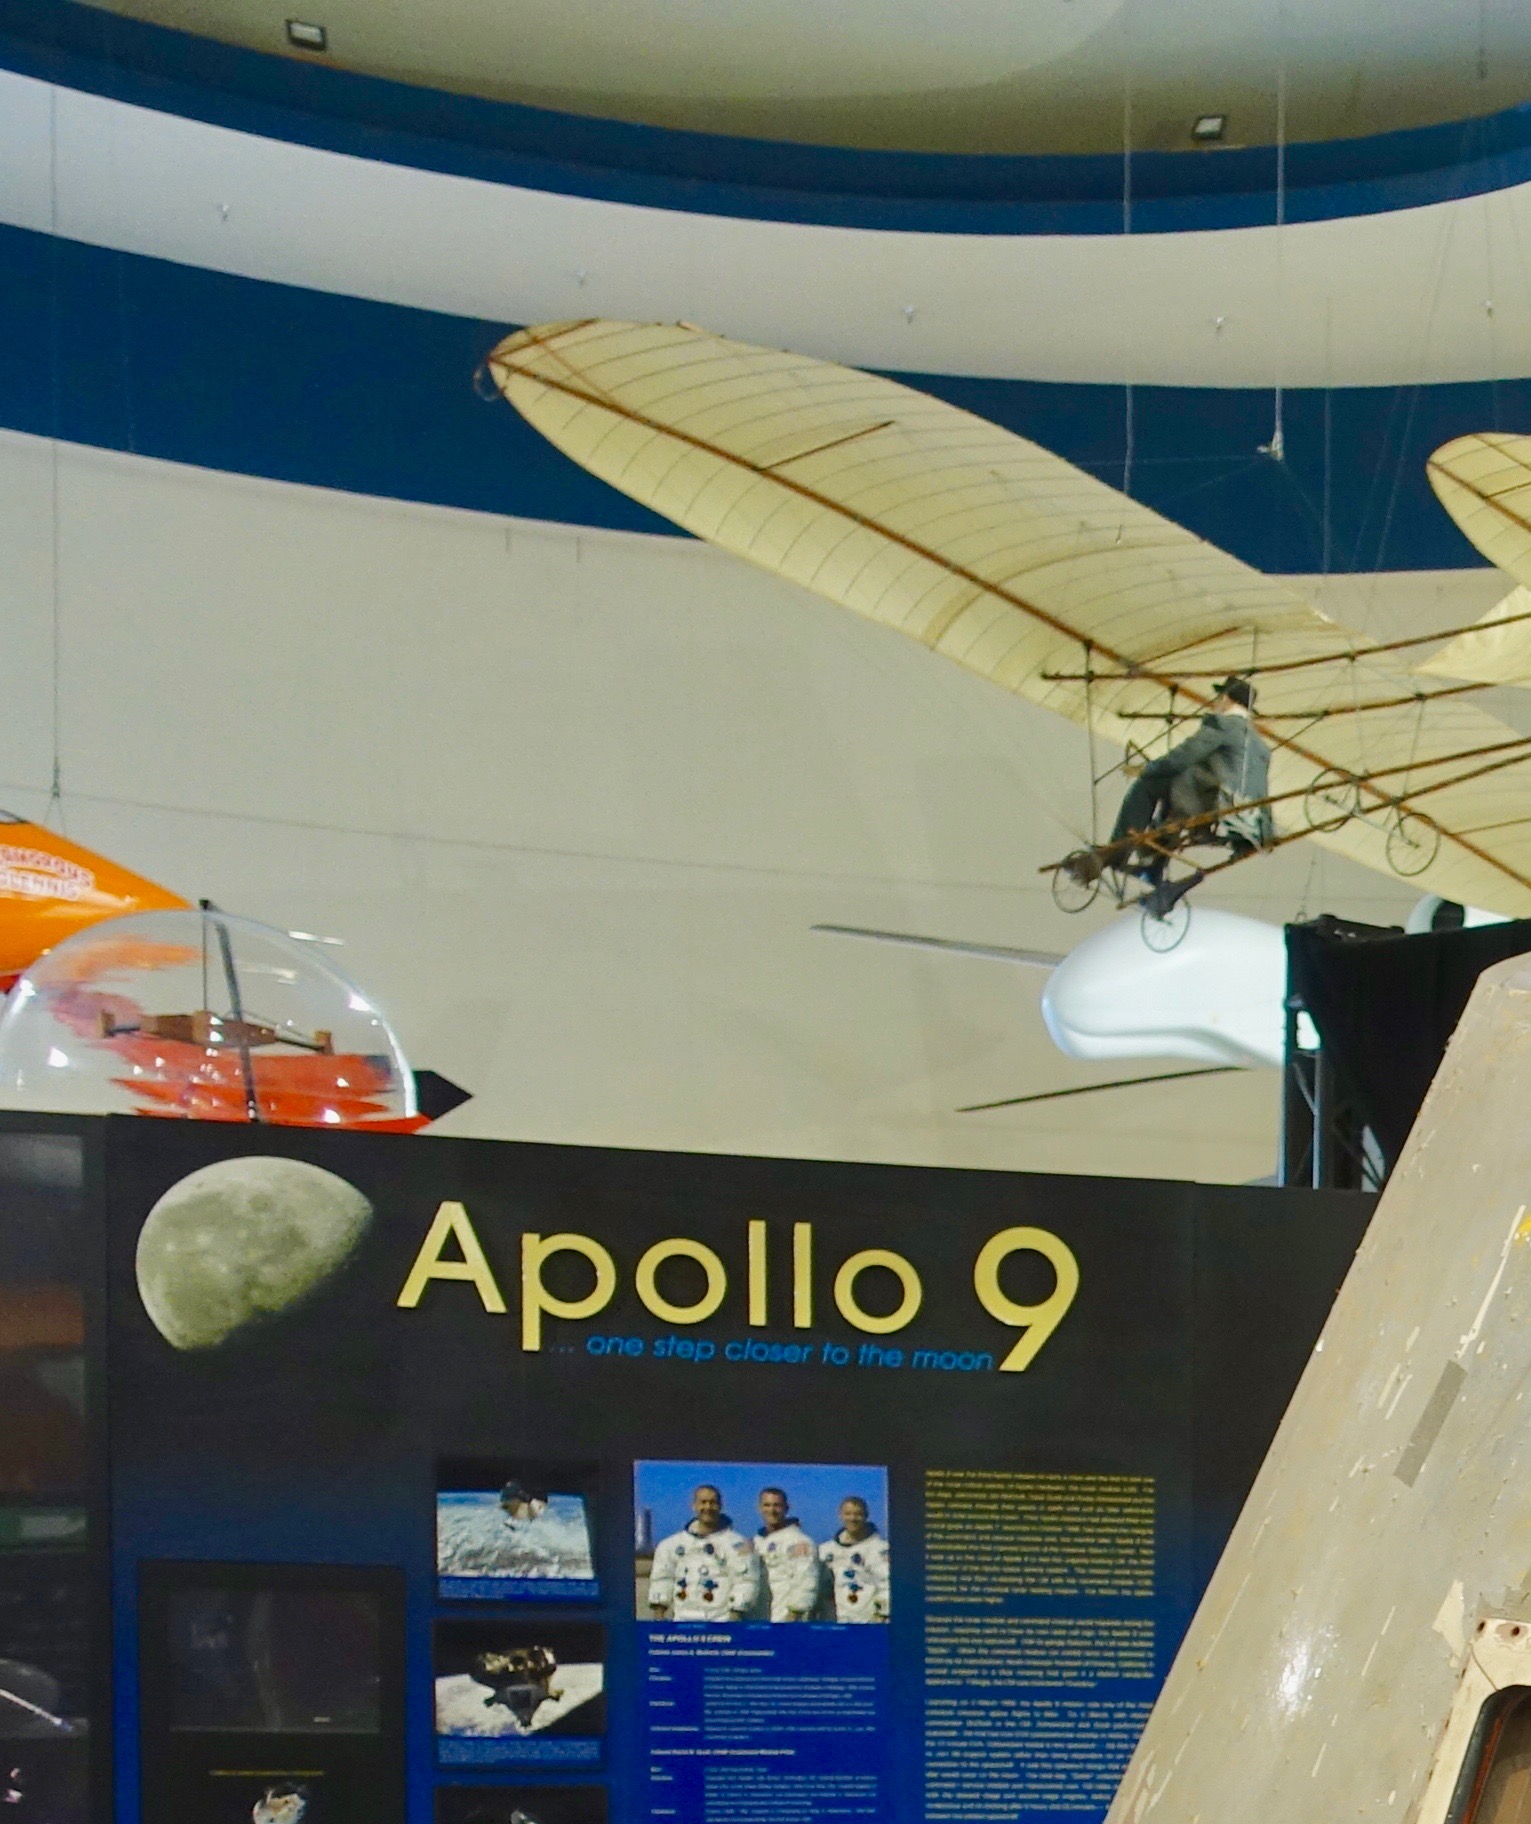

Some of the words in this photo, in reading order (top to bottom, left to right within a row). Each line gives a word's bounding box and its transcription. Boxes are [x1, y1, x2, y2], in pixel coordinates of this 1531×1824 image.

[397, 1200, 922, 1352] Apollo
[973, 1226, 1080, 1372] 9
[586, 1335, 644, 1358] one
[653, 1336, 717, 1363] step
[725, 1338, 811, 1364] closer
[822, 1343, 849, 1367] to
[858, 1343, 904, 1369] the
[912, 1351, 994, 1372] moon
